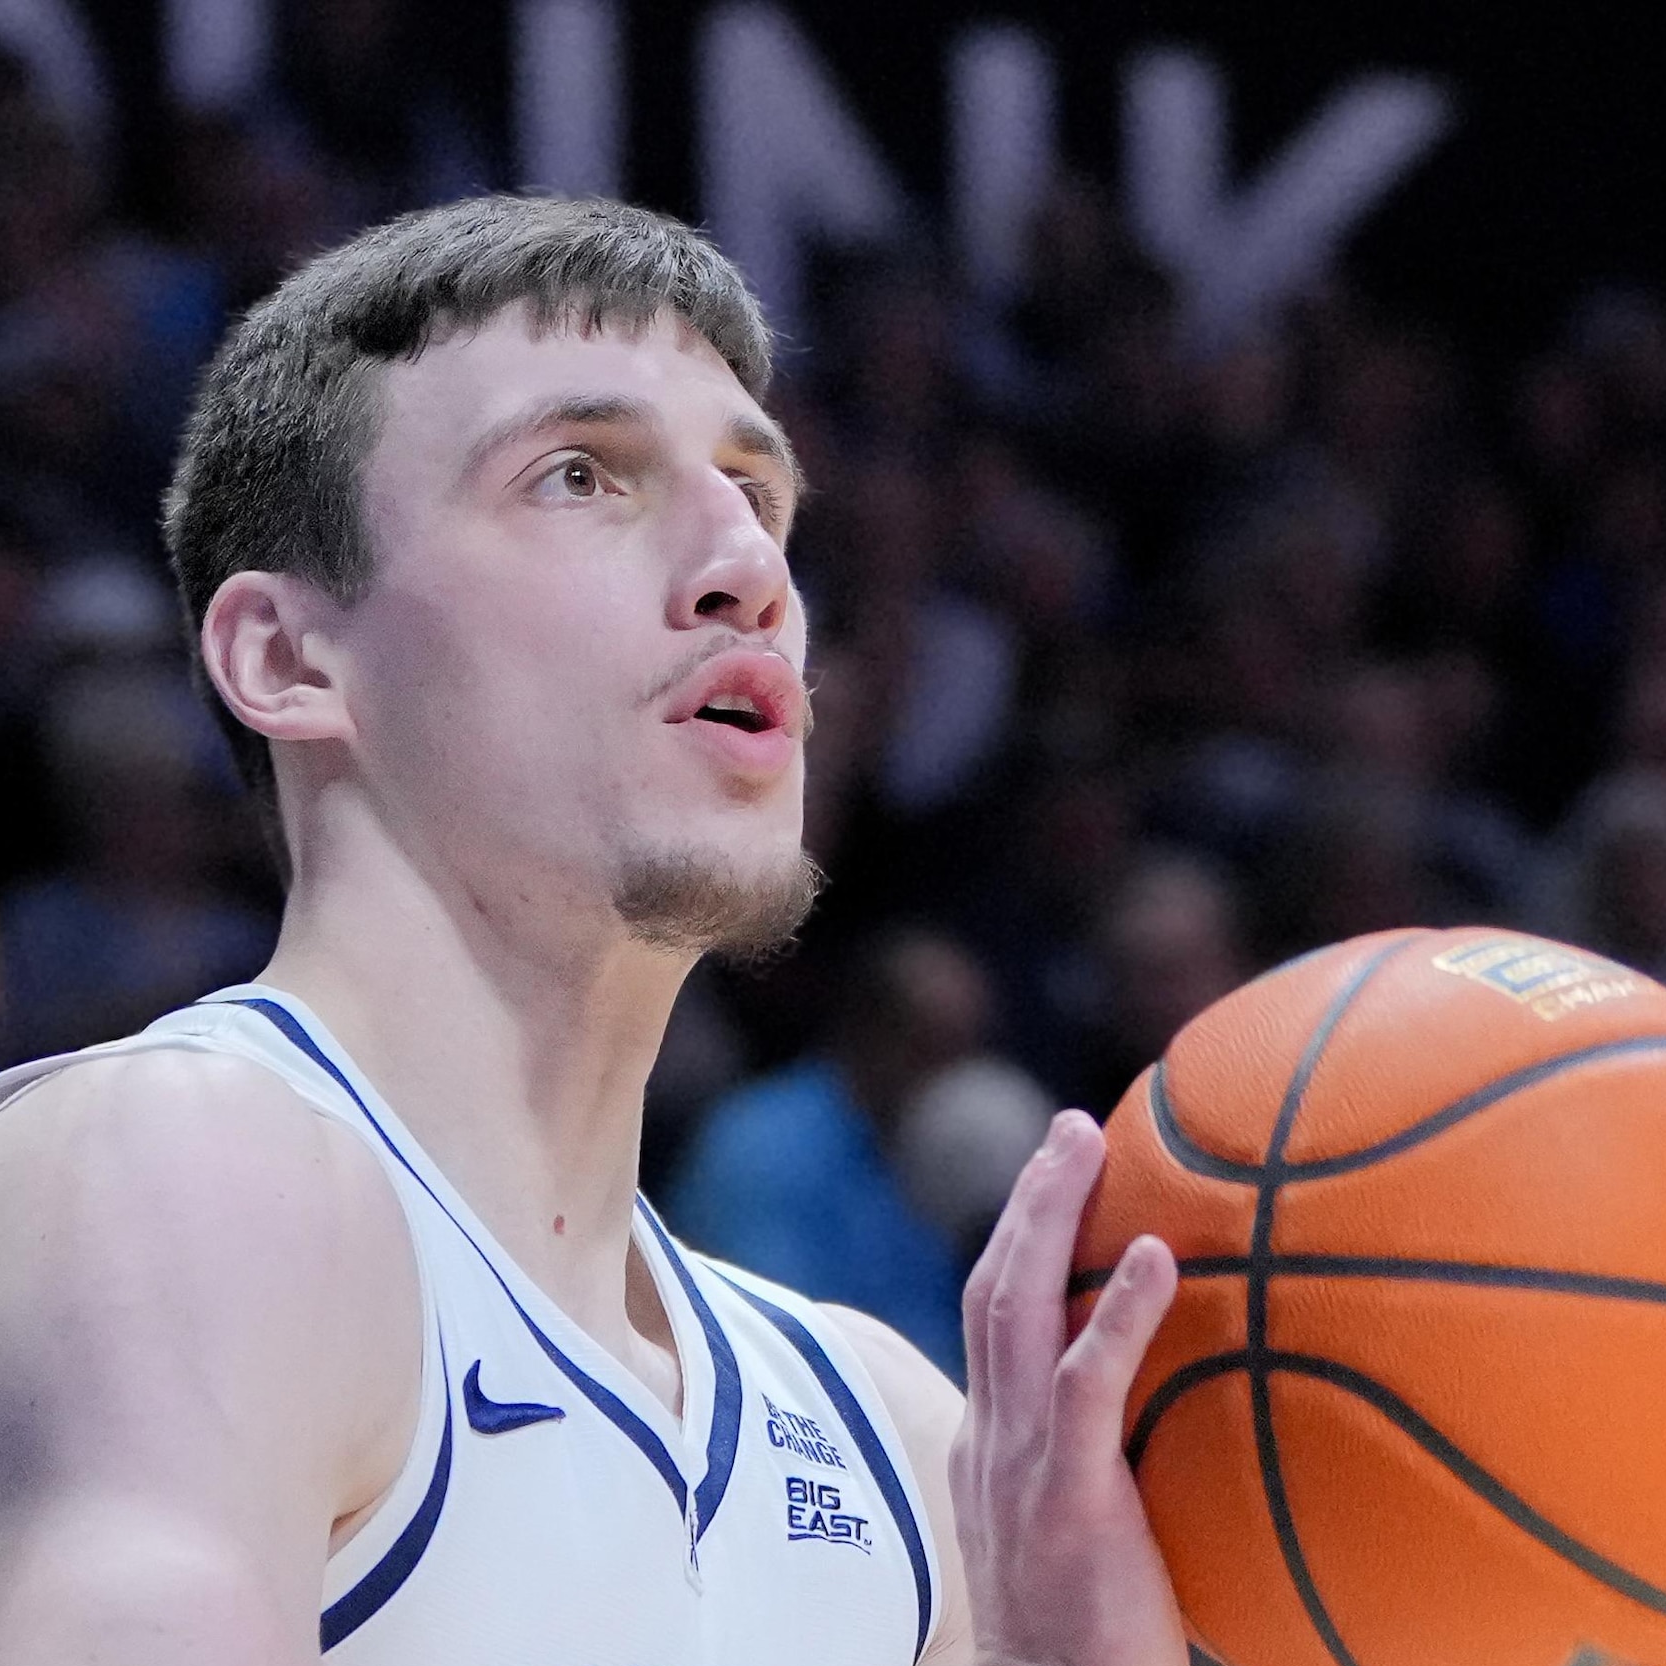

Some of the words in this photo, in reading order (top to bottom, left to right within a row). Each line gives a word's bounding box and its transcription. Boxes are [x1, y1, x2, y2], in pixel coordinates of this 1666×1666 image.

[780, 1410, 829, 1442] THE
[767, 1419, 848, 1471] CHANGE
[786, 1477, 841, 1510] BIG
[788, 1504, 869, 1541] EAST
